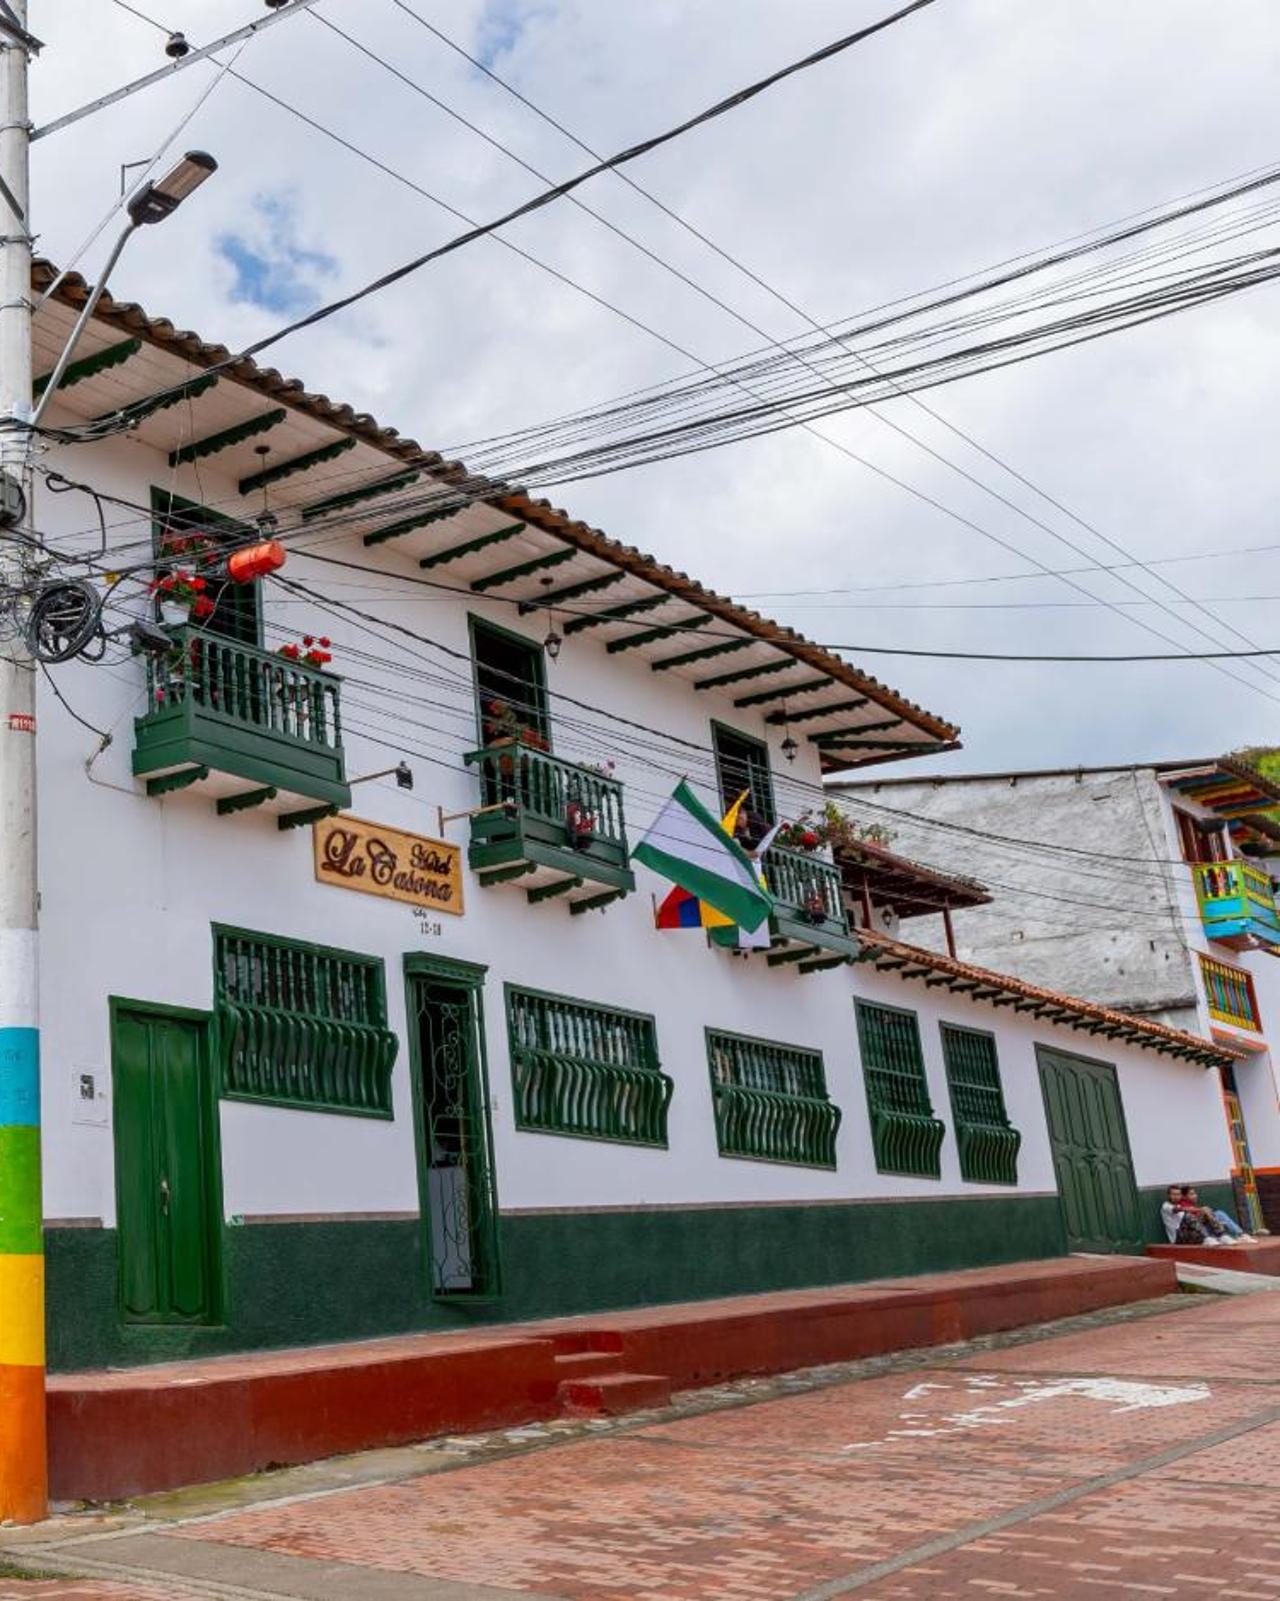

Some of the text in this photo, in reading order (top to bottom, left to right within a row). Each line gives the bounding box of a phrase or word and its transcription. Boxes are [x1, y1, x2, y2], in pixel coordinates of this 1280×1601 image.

[321, 829, 453, 901] La Casona
[409, 843, 453, 875] Hotel
